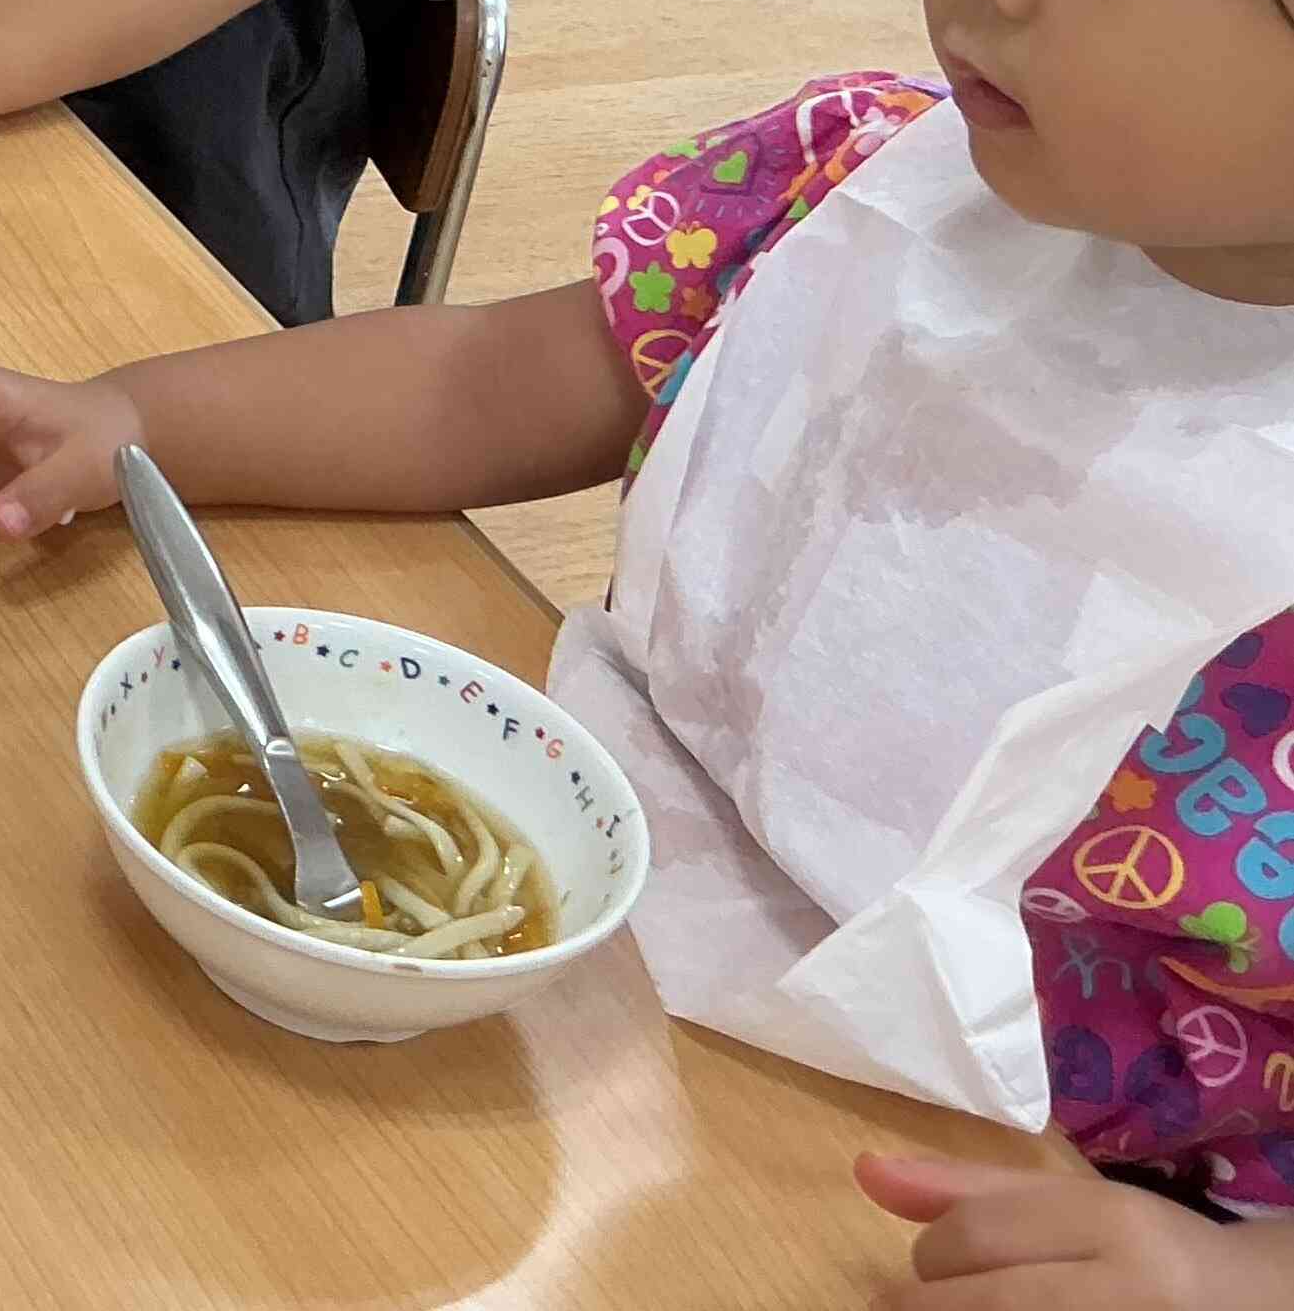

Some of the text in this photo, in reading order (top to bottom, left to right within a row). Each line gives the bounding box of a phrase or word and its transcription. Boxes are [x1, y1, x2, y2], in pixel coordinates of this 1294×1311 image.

[120, 671, 133, 699] X
[292, 623, 309, 645] B
[339, 649, 360, 668] C
[400, 657, 421, 680] D
[460, 680, 485, 703] E
[503, 718, 520, 741] F
[546, 738, 565, 759] G
[575, 786, 595, 812] H
[605, 814, 621, 838] I
